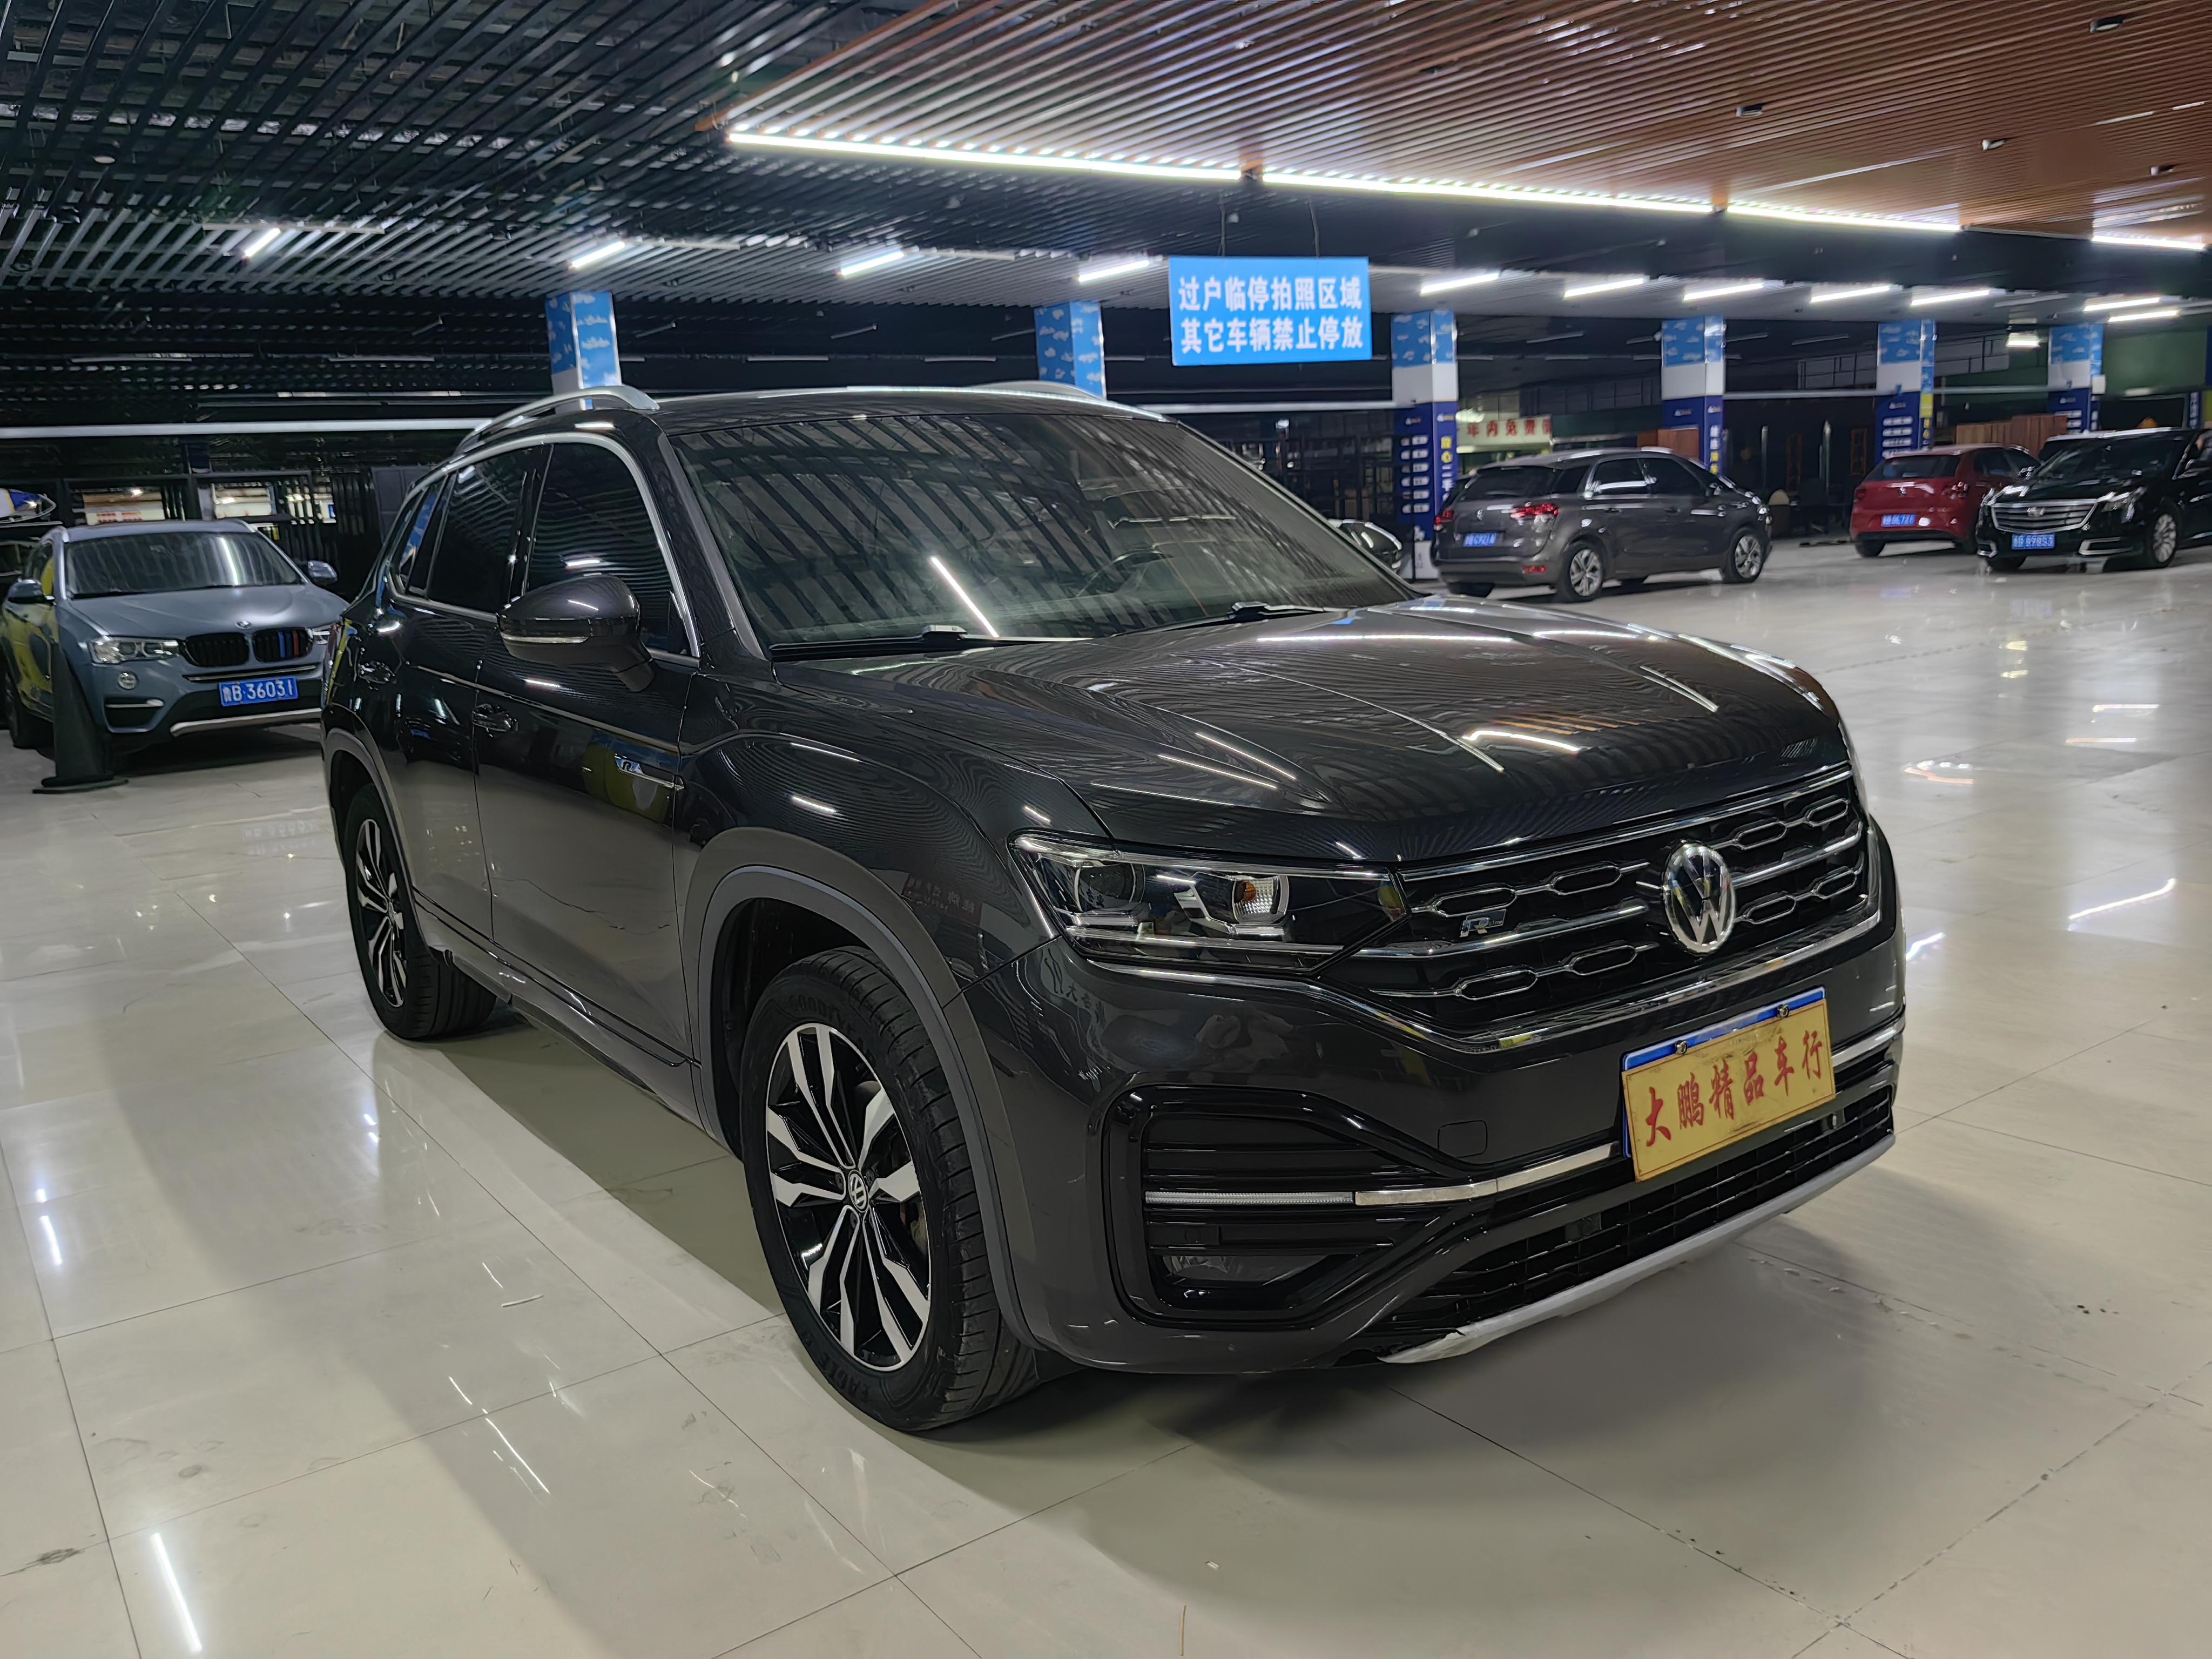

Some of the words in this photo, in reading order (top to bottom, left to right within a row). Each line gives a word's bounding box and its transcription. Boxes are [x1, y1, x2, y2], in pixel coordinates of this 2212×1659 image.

[1178, 276, 1362, 312] 过户临停拍照区域
[1180, 316, 1363, 354] 其它车辆禁止停放
[1645, 1029, 1823, 1148] 大鹏精品车行
